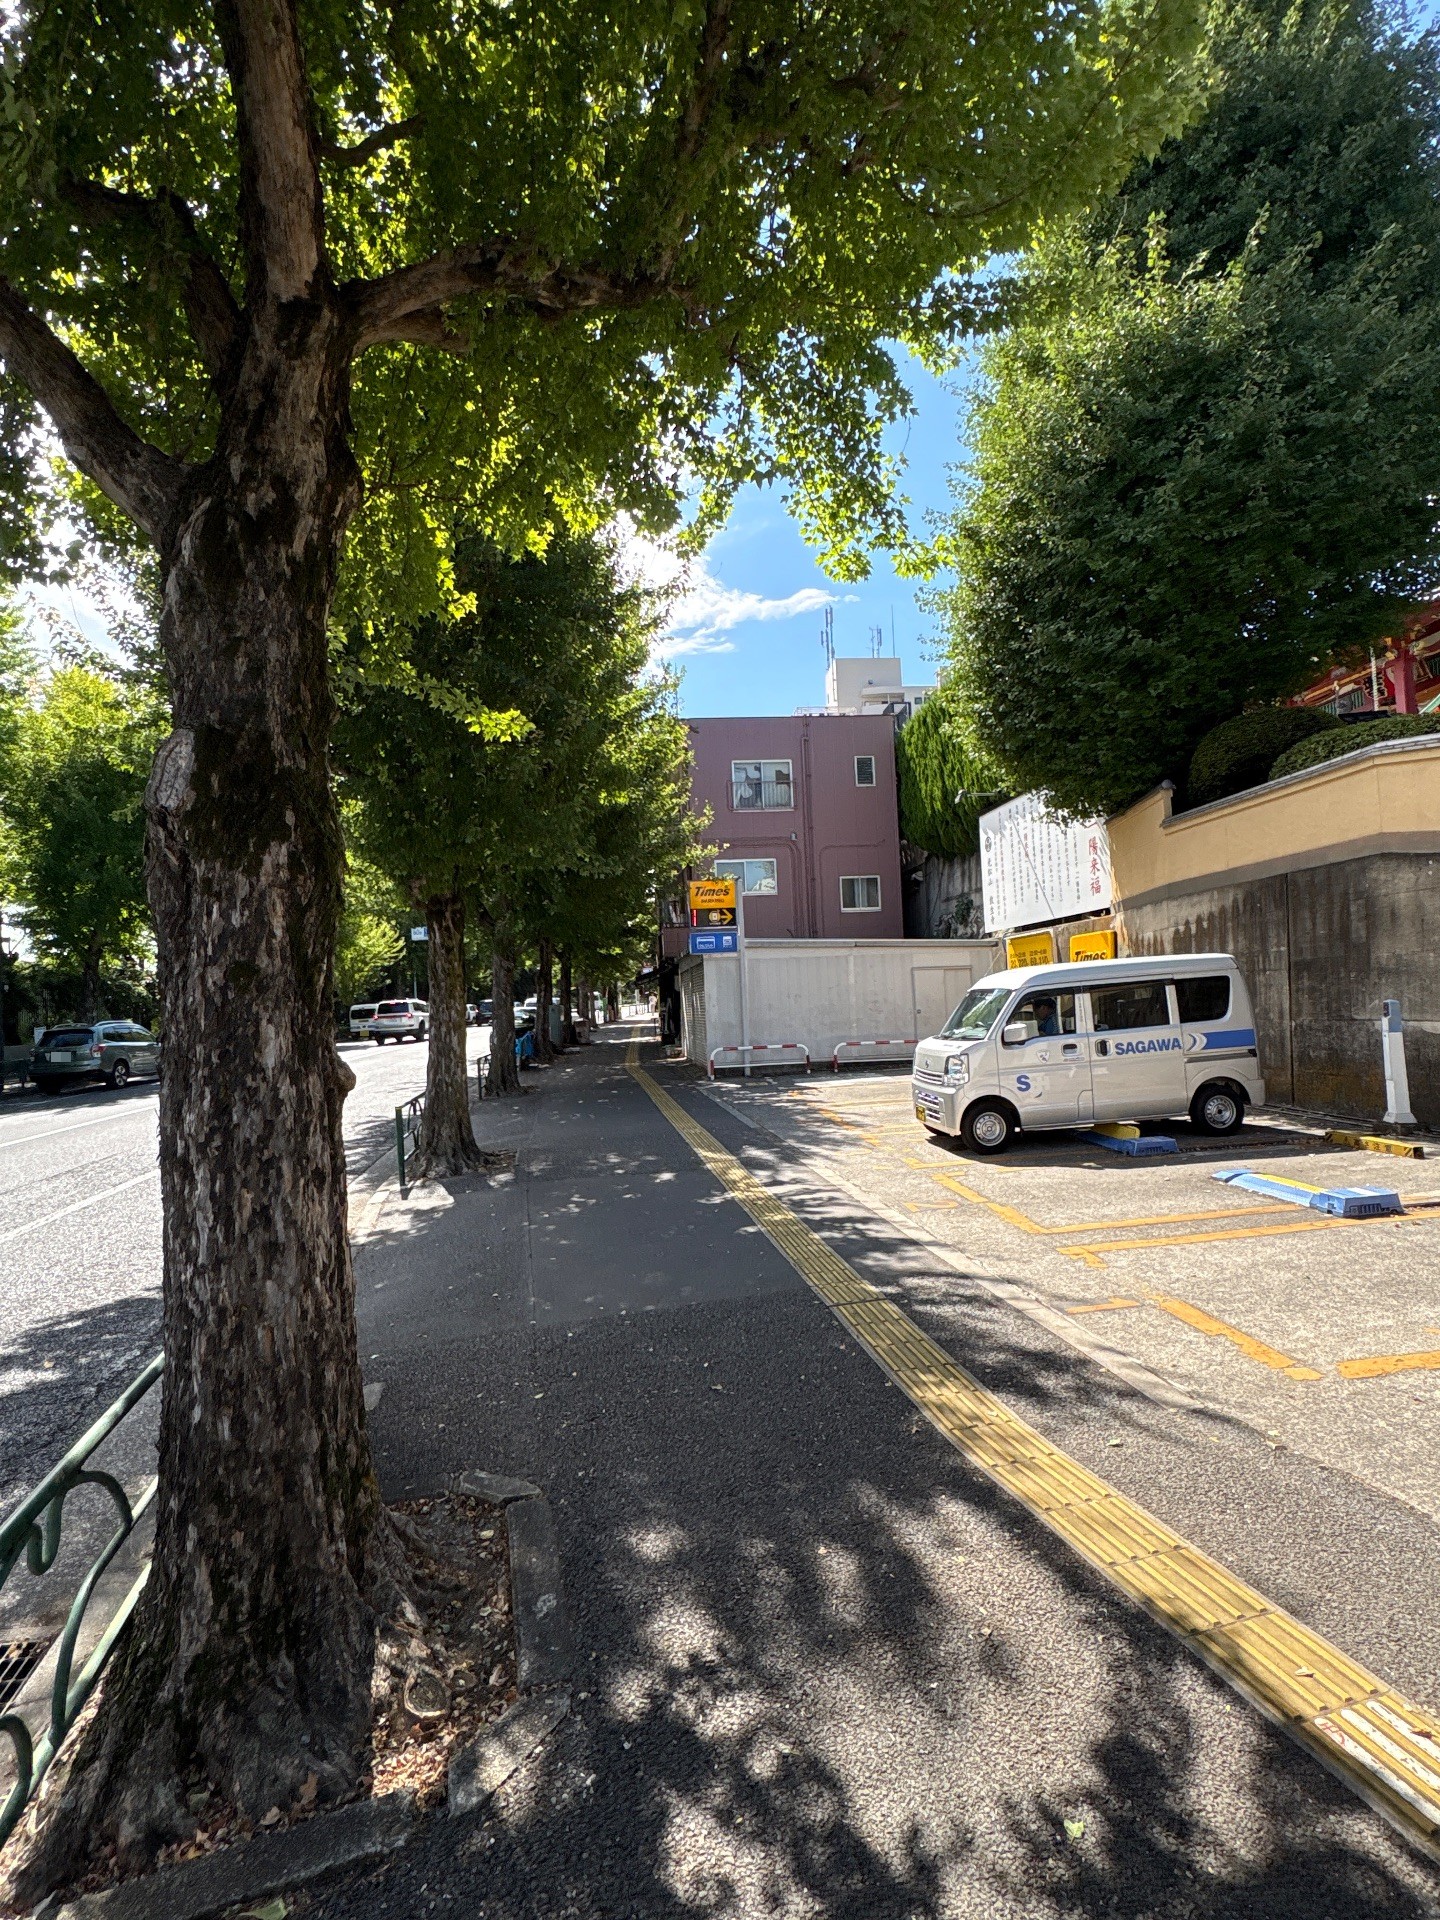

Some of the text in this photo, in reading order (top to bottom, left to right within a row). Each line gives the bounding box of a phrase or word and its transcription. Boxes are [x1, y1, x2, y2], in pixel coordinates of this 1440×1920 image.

[695, 886, 730, 897] Times
[1072, 950, 1107, 962] Times
[1115, 1037, 1182, 1055] SAGAWA
